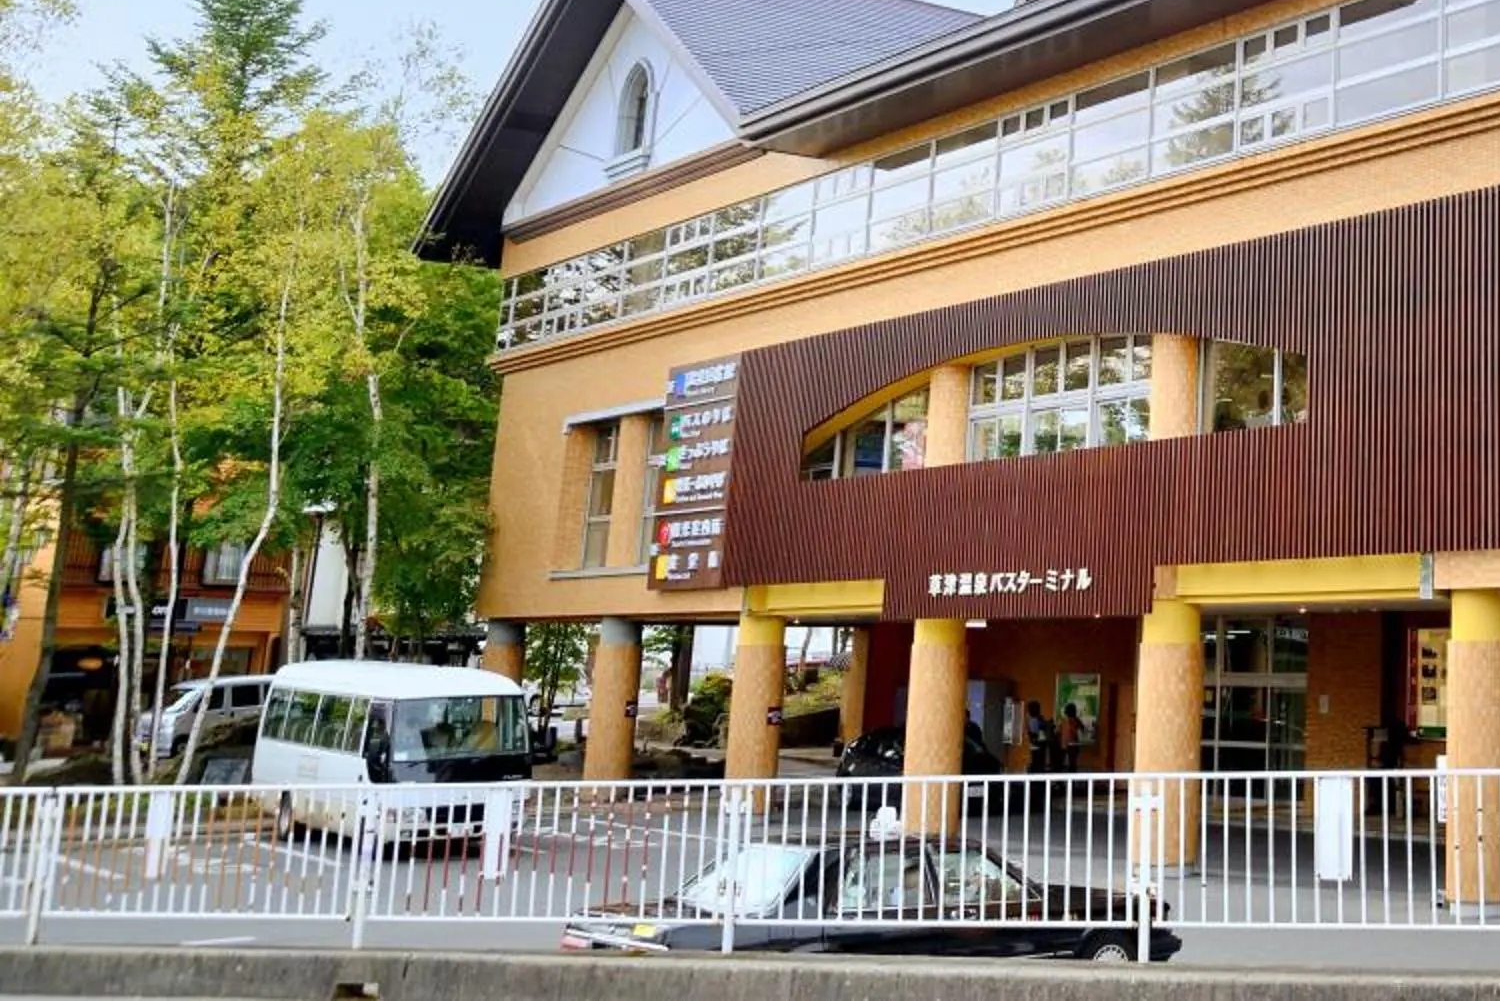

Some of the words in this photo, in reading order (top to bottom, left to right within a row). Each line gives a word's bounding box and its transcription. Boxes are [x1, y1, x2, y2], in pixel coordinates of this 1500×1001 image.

[928, 567, 1092, 597] 草津温泉バスターミナル
